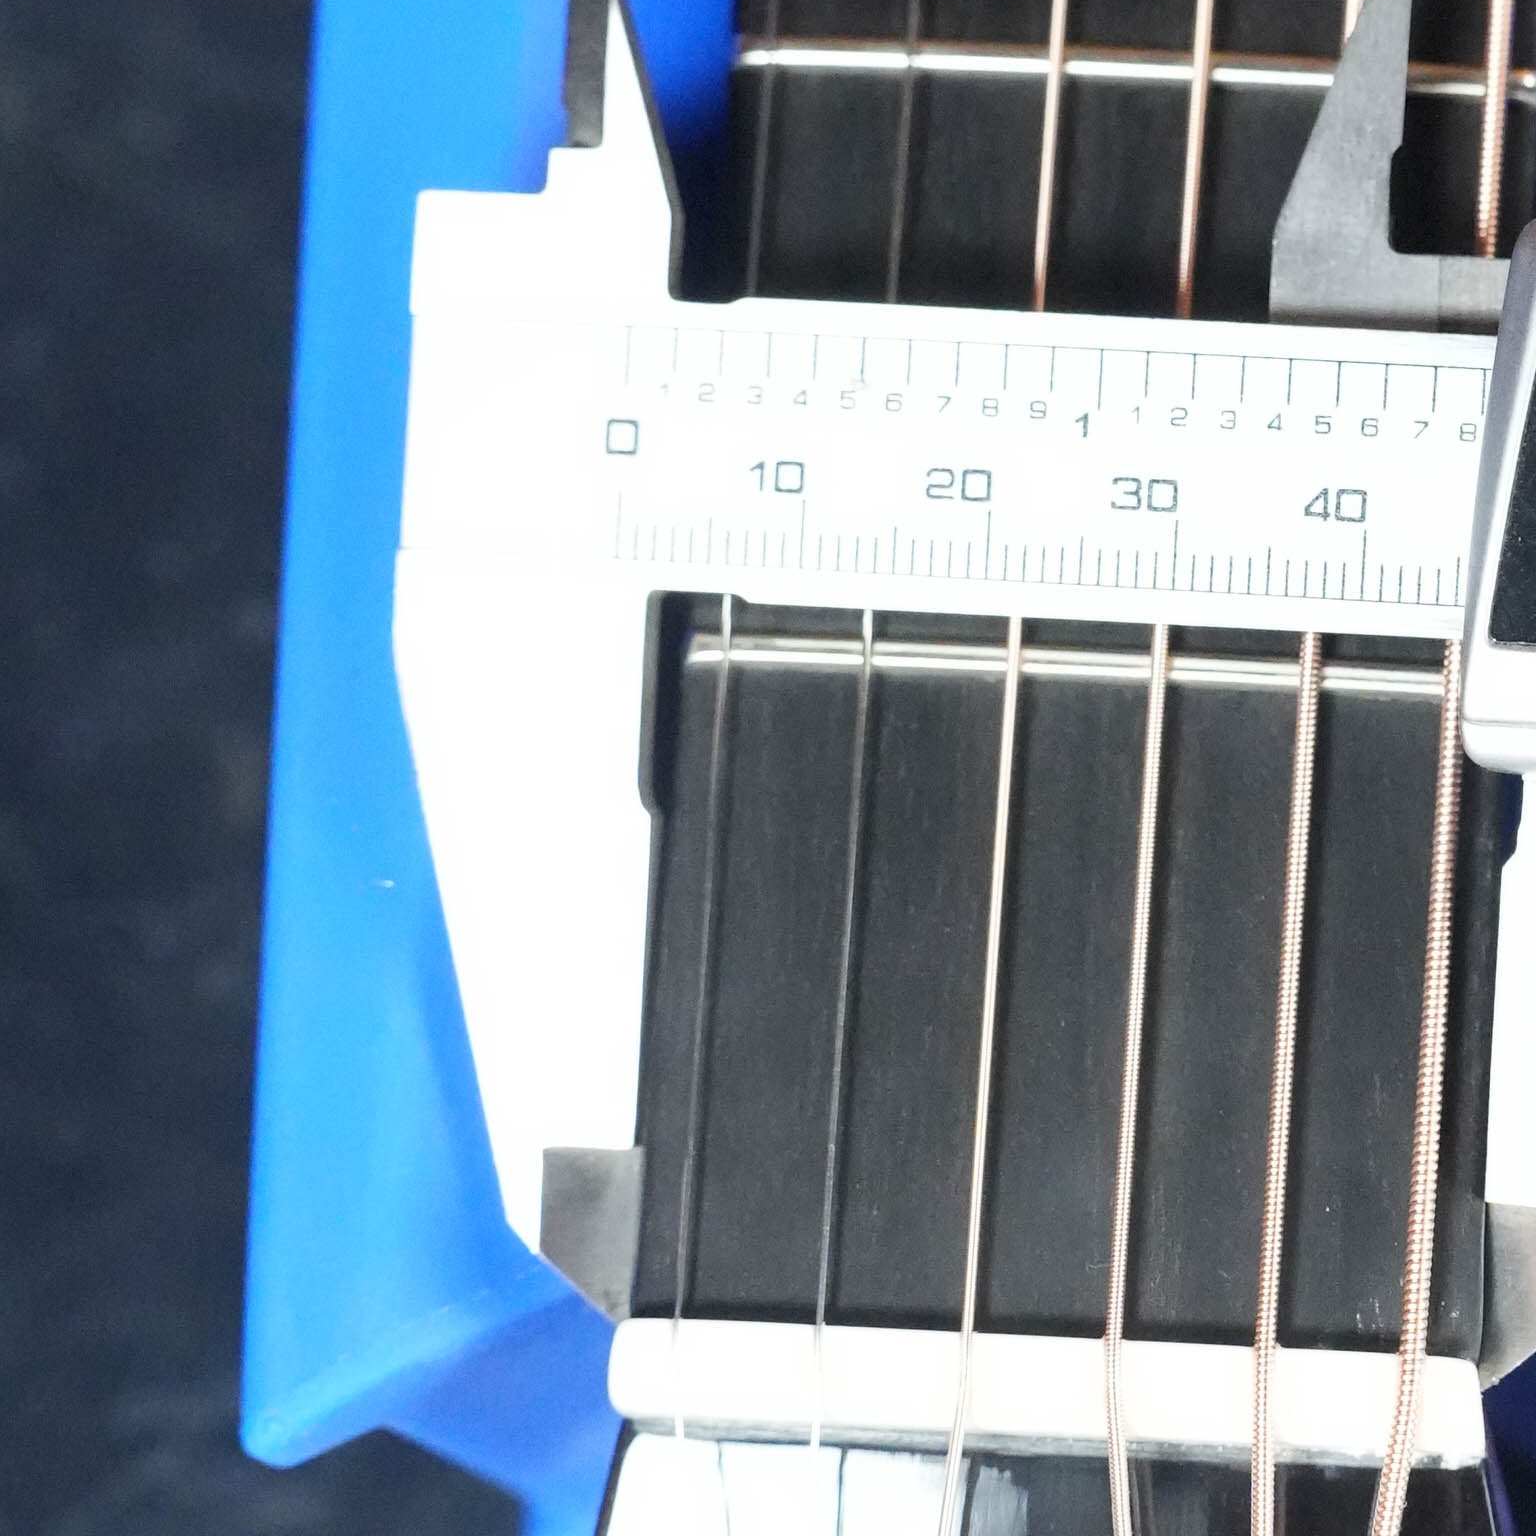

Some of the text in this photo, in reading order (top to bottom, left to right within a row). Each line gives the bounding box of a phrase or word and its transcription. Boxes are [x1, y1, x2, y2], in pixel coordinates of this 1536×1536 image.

[698, 382, 716, 403] 2
[747, 385, 763, 405] 3
[793, 389, 808, 407] 4
[840, 390, 857, 410] 5
[885, 393, 903, 413] 6
[936, 396, 951, 413] 7
[982, 398, 999, 417] 8
[1029, 400, 1047, 420] 9
[1075, 413, 1089, 438] 1
[1131, 406, 1141, 425] 1
[1170, 407, 1188, 427] 2
[1219, 410, 1237, 430] 3
[1267, 413, 1283, 432] 4
[1314, 415, 1332, 434] 5
[1361, 417, 1379, 437] 6
[1413, 420, 1429, 439] 7
[1459, 422, 1477, 442] 8
[606, 419, 1368, 523] 0 10 20 30 40
